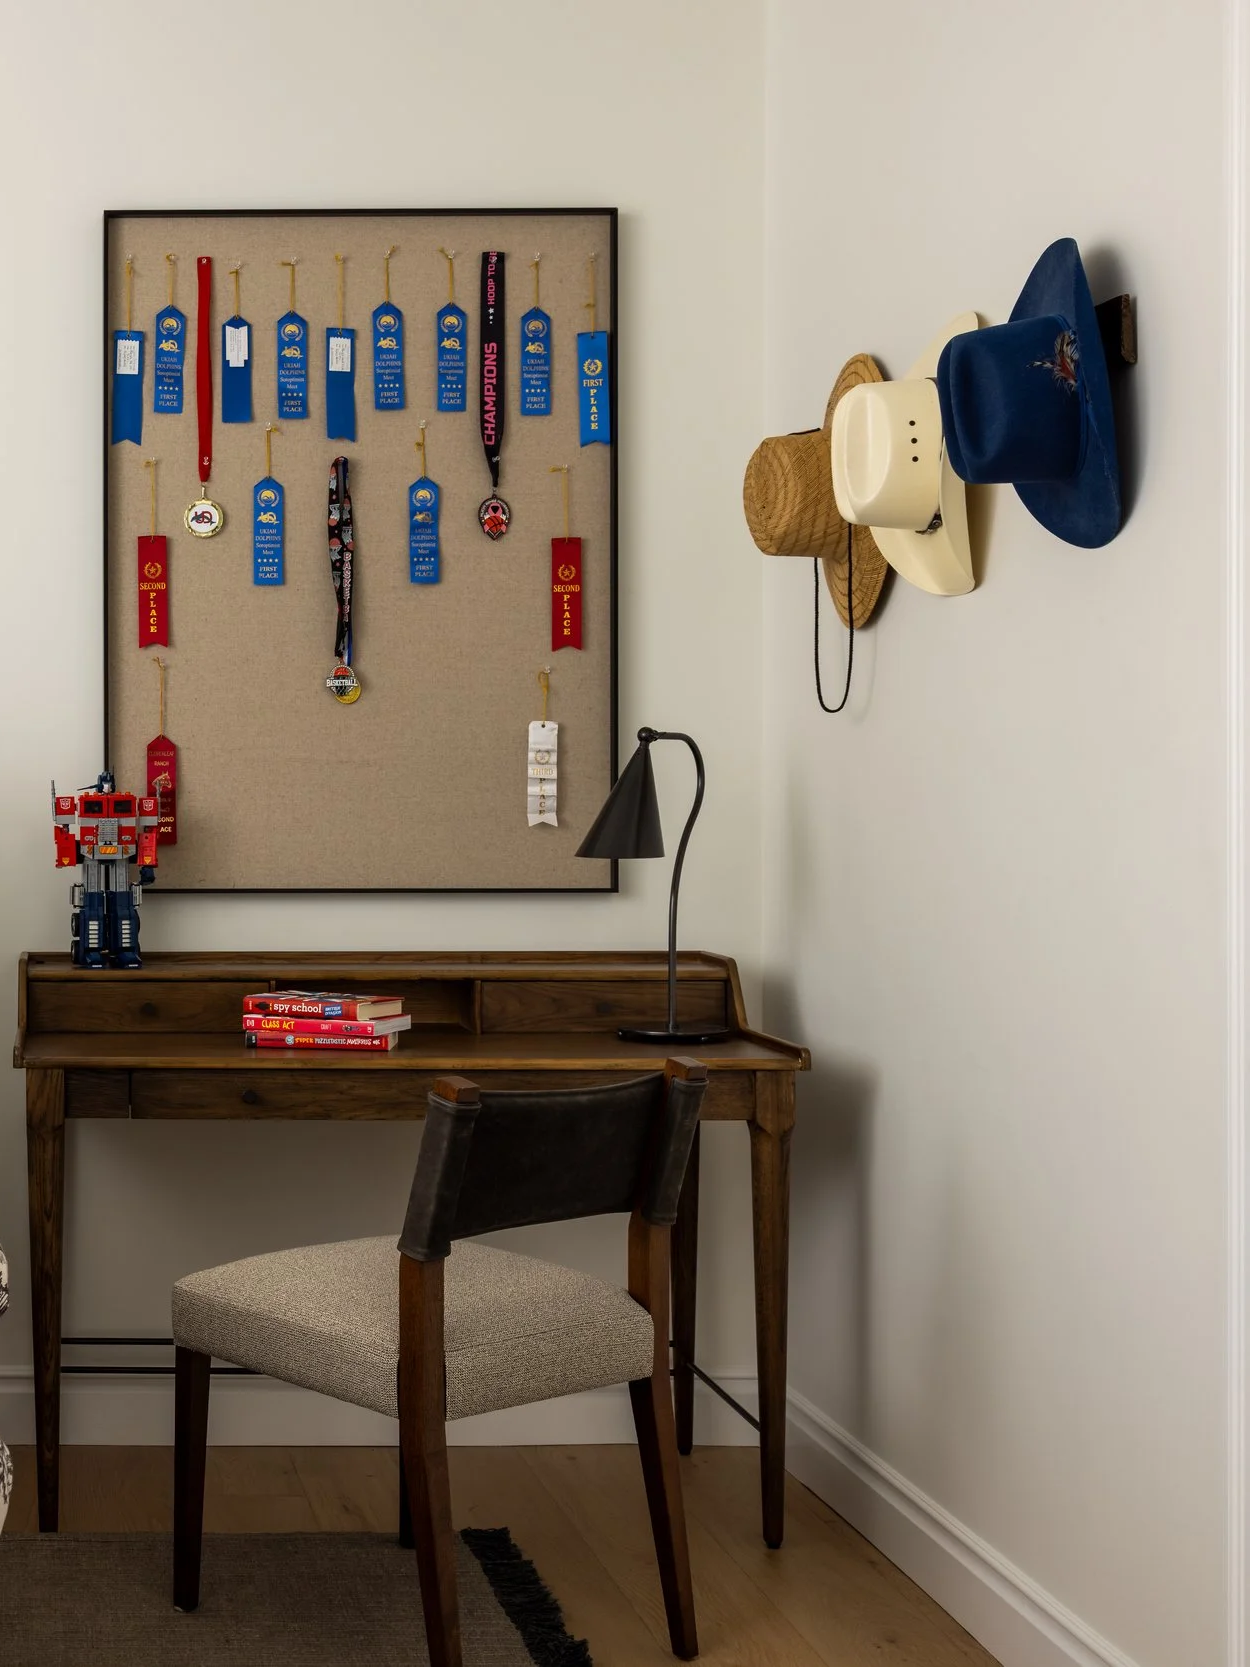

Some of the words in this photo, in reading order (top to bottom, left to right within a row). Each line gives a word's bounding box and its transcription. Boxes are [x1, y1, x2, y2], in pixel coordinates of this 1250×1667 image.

[583, 378, 603, 387] FIRST
[484, 342, 497, 446] CHAMPIONS
[590, 388, 598, 430] PLACE
[554, 584, 580, 592] SECOND
[326, 678, 357, 687] BASKETBALL
[274, 1004, 290, 1013] spy
[292, 1003, 322, 1013] school
[262, 1020, 280, 1028] CLASS
[282, 1020, 294, 1029] ACT
